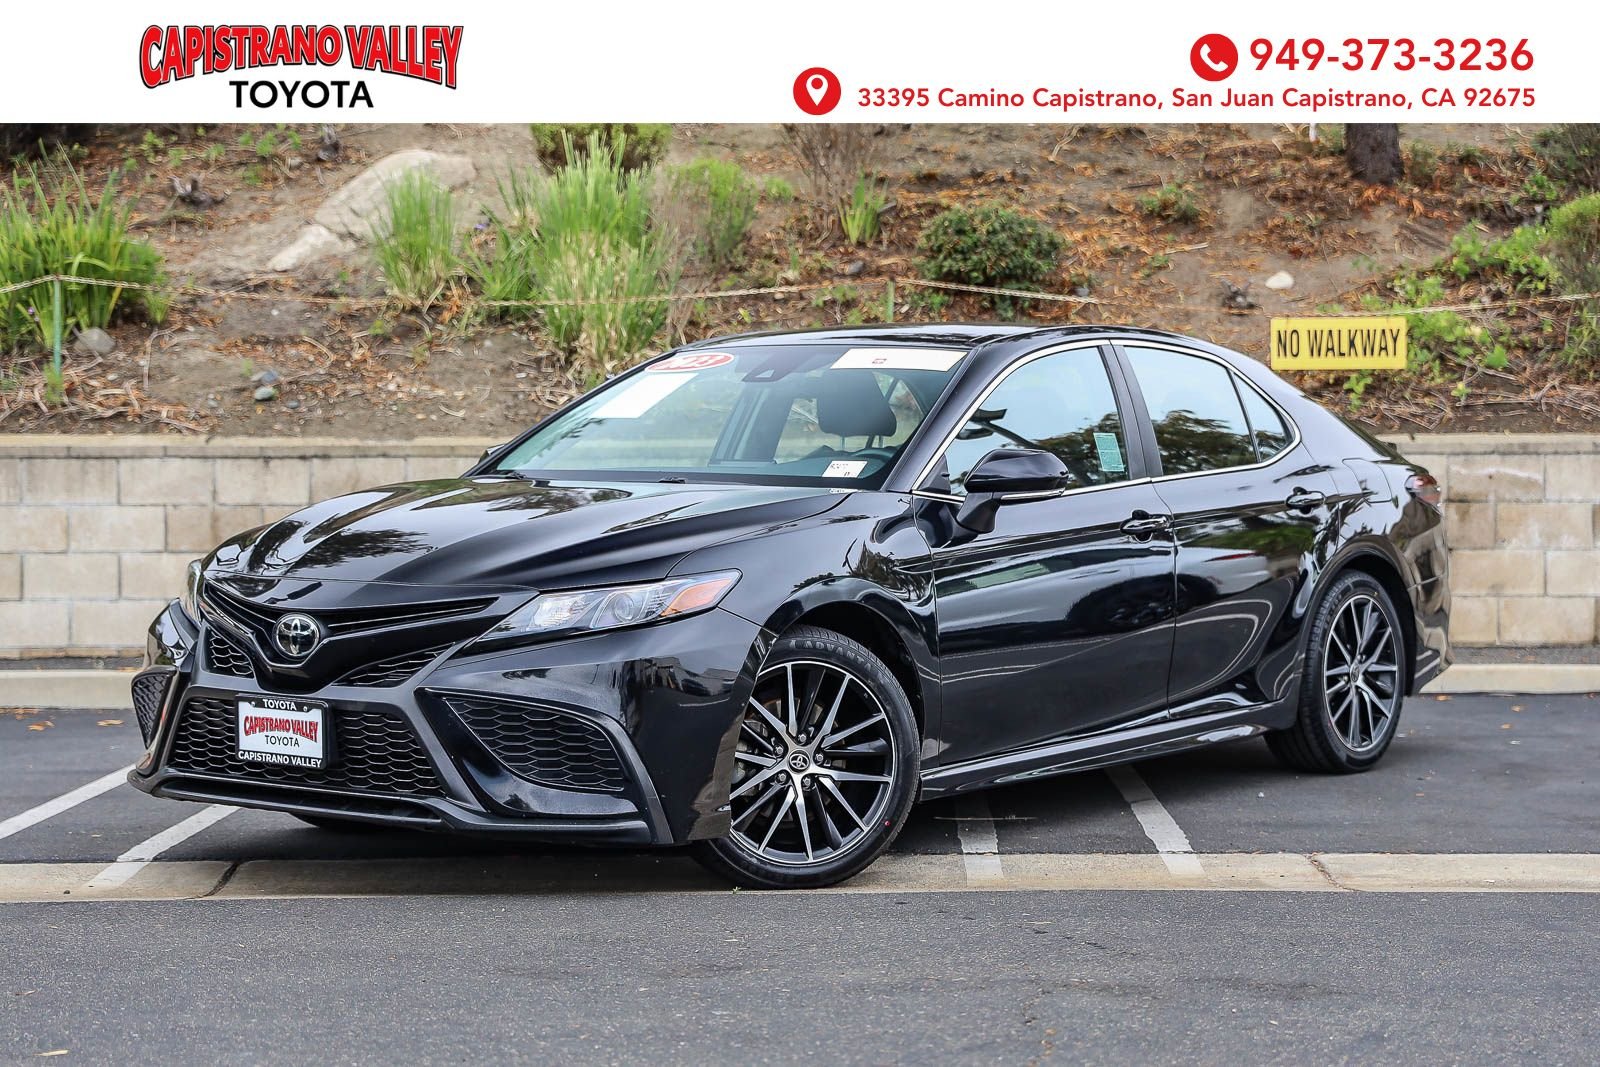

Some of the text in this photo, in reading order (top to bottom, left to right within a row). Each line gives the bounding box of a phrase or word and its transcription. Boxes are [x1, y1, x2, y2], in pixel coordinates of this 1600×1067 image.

[1277, 328, 1400, 358] NO WALKWAY
[263, 699, 297, 710] TOYOTA
[244, 715, 318, 743] CAPISTRANO VALLEY
[265, 735, 299, 747] TOYOTA
[238, 751, 321, 767] CAPISTRANO VALLEY
